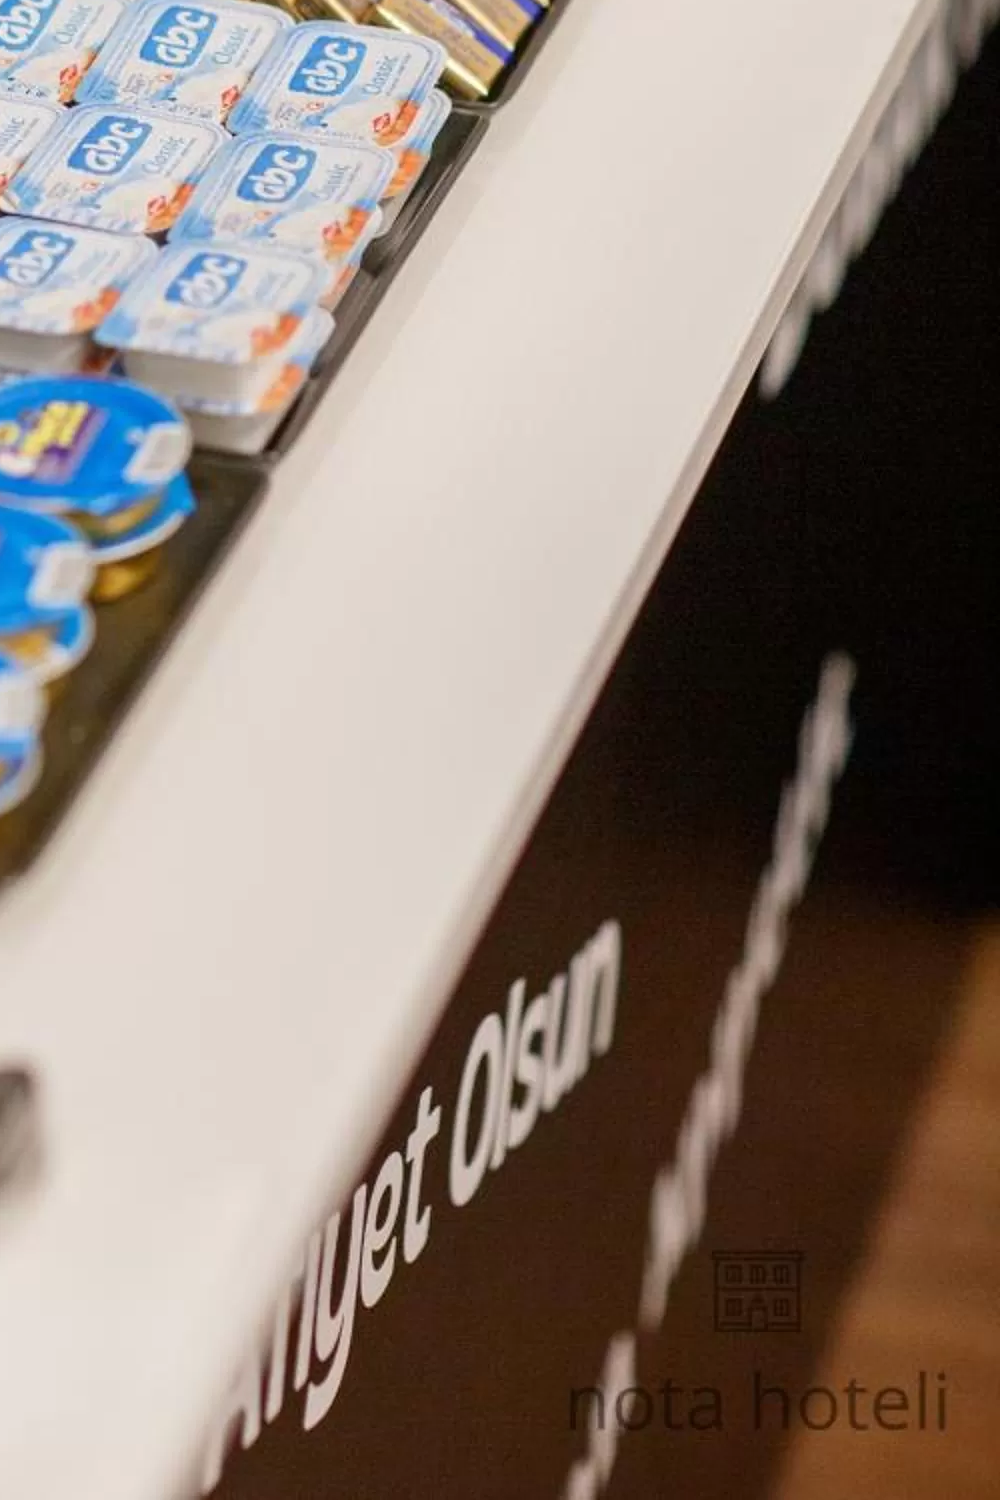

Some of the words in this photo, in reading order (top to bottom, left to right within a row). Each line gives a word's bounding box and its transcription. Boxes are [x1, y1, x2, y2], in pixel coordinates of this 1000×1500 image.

[152, 10, 210, 64] abc
[301, 42, 358, 93] abc
[81, 121, 143, 172] abc
[247, 149, 308, 199] abc
[6, 236, 66, 285] abc
[176, 254, 240, 303] abc
[449, 917, 622, 1208] Olsun
